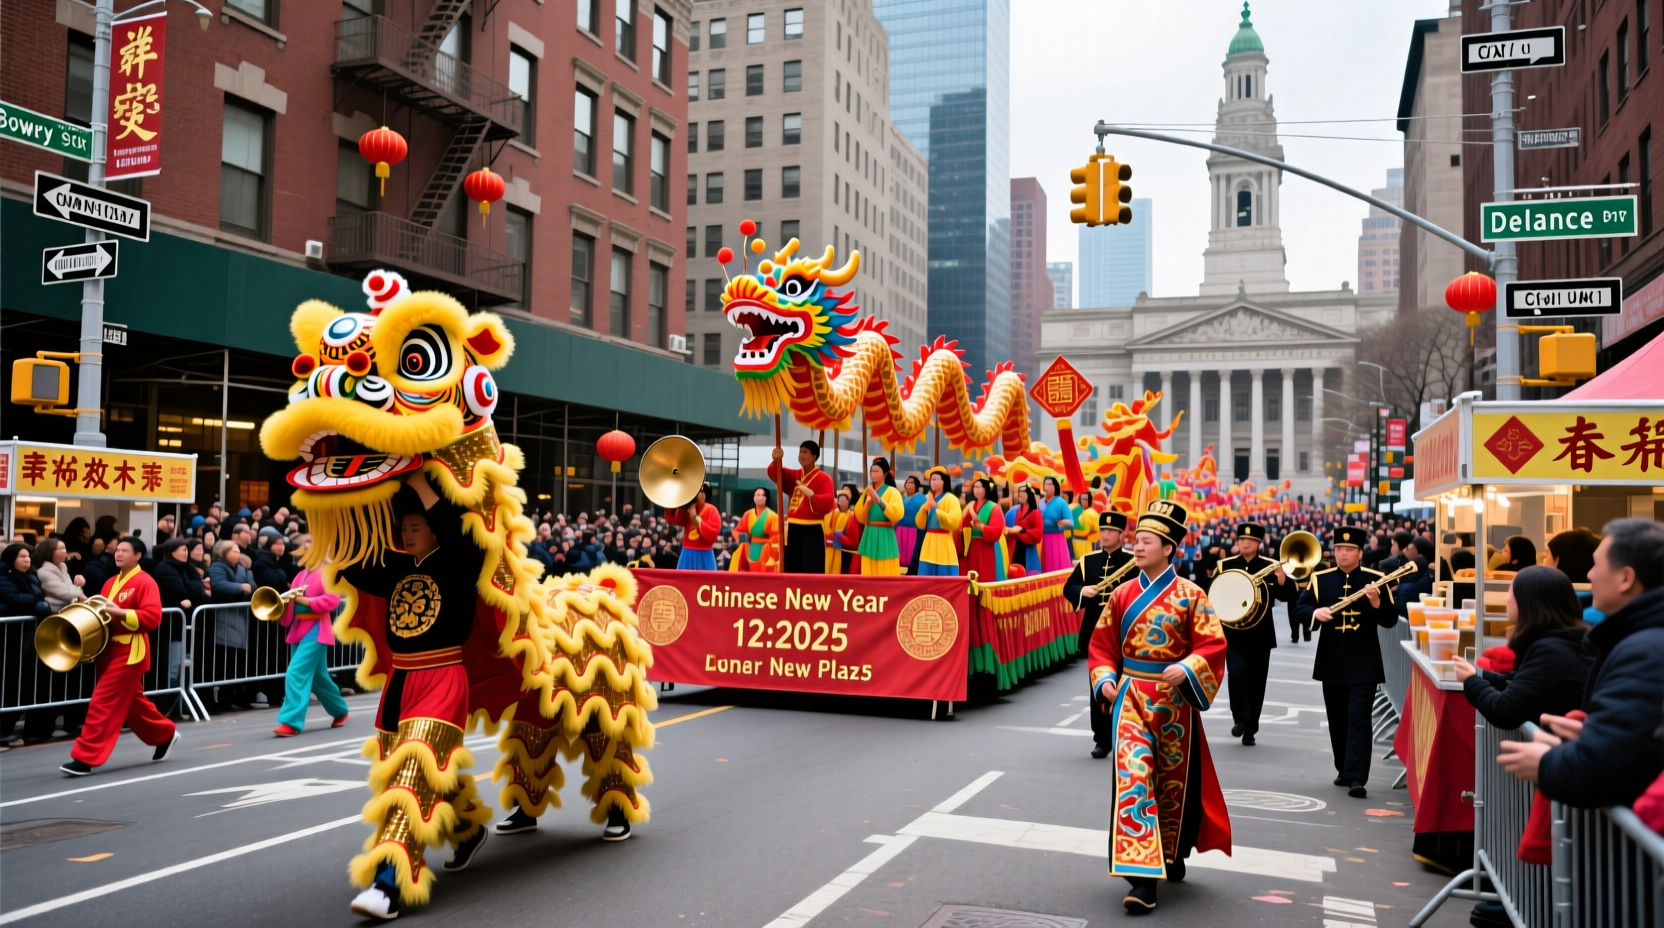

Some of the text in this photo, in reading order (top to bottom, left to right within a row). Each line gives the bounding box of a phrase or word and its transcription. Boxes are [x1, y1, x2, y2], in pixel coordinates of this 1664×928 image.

[1491, 208, 1594, 233] Delance
[697, 585, 889, 613] Chinese New Year
[732, 618, 849, 652] 12:2025
[770, 657, 811, 678] New
